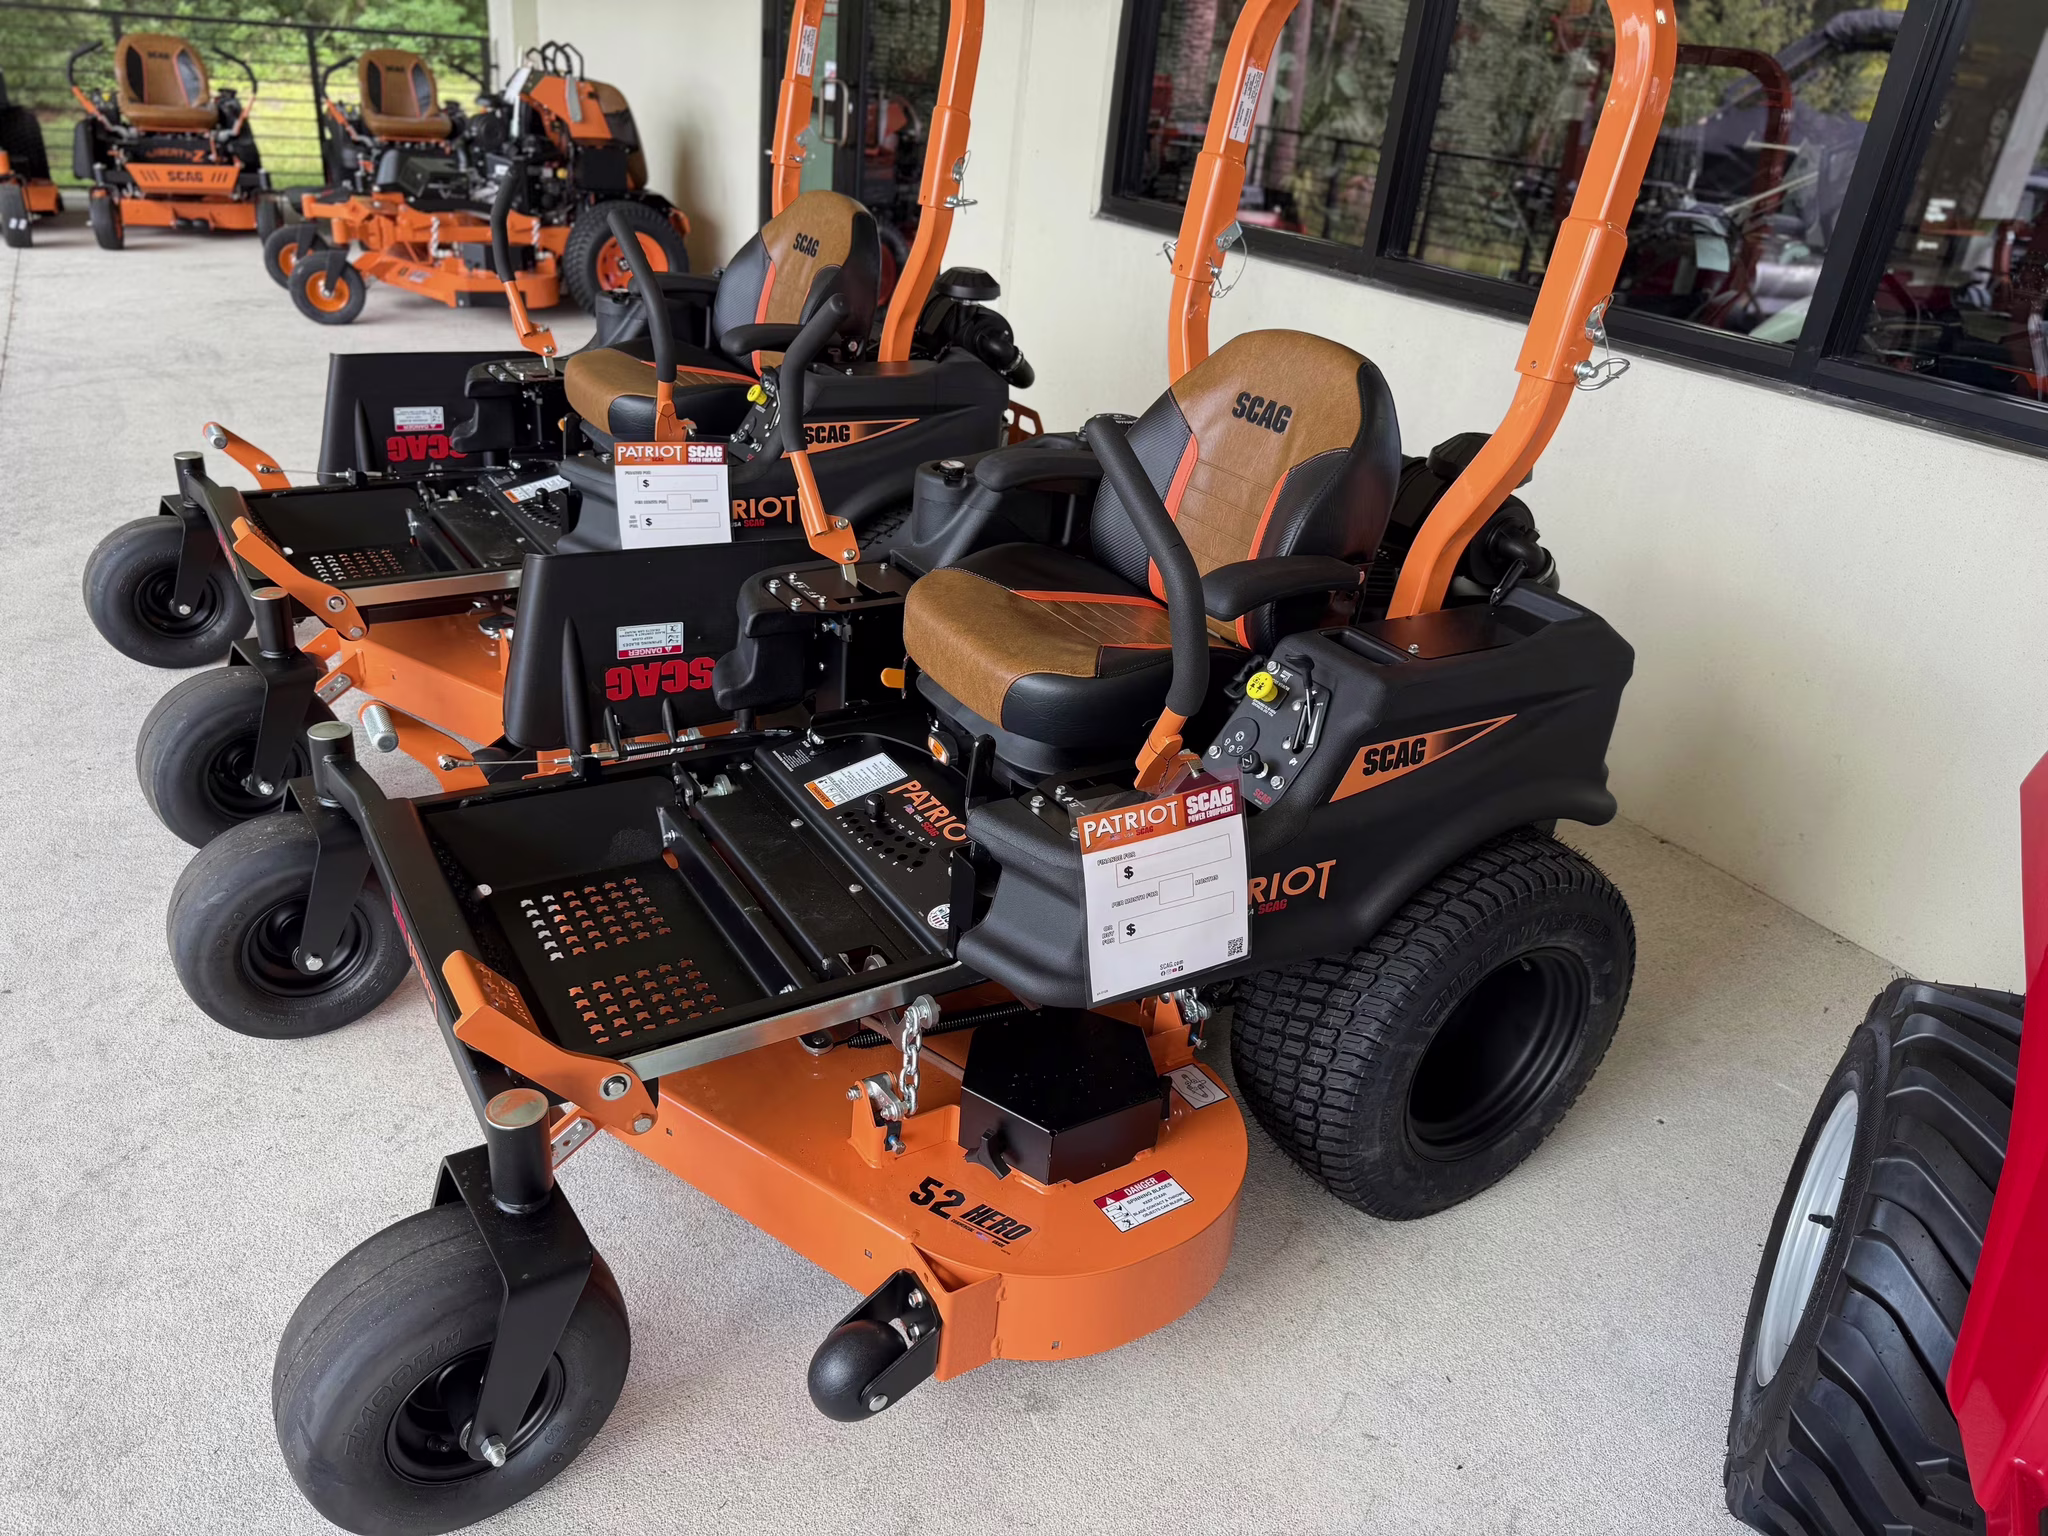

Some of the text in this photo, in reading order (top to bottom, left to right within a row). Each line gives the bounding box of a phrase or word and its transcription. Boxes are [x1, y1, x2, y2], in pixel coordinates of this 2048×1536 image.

[167, 171, 203, 182] SCAG
[793, 232, 819, 258] SCAG
[1232, 391, 1293, 434] SCAG
[804, 425, 851, 445] SCAG
[617, 445, 682, 462] PATRIOT
[687, 445, 723, 458] SCAG
[642, 479, 650, 488] $
[645, 518, 653, 527] $
[743, 519, 765, 527] SCAG
[628, 647, 663, 657] DANGER
[605, 656, 716, 702] SCAG
[1362, 737, 1427, 777] SCAG
[1186, 786, 1234, 815] SCAG
[1252, 788, 1272, 805] SCAG
[1188, 803, 1234, 824] POWER EQUIPMENT
[920, 821, 940, 837] SCAG
[1083, 801, 1178, 848] PATRIOT
[1136, 825, 1154, 836] SCAG
[1096, 851, 1136, 867] FINANCE FOR
[1123, 865, 1134, 880] $
[1258, 898, 1288, 915] SCAG
[1126, 923, 1136, 937] $
[1159, 959, 1184, 971] SCAG.com
[1123, 1177, 1159, 1196] DANGER
[1126, 1182, 1173, 1205] SPINNING BLADES
[1142, 1192, 1167, 1205] KEEP CLEAR
[908, 1175, 1033, 1241] 52 HERO
